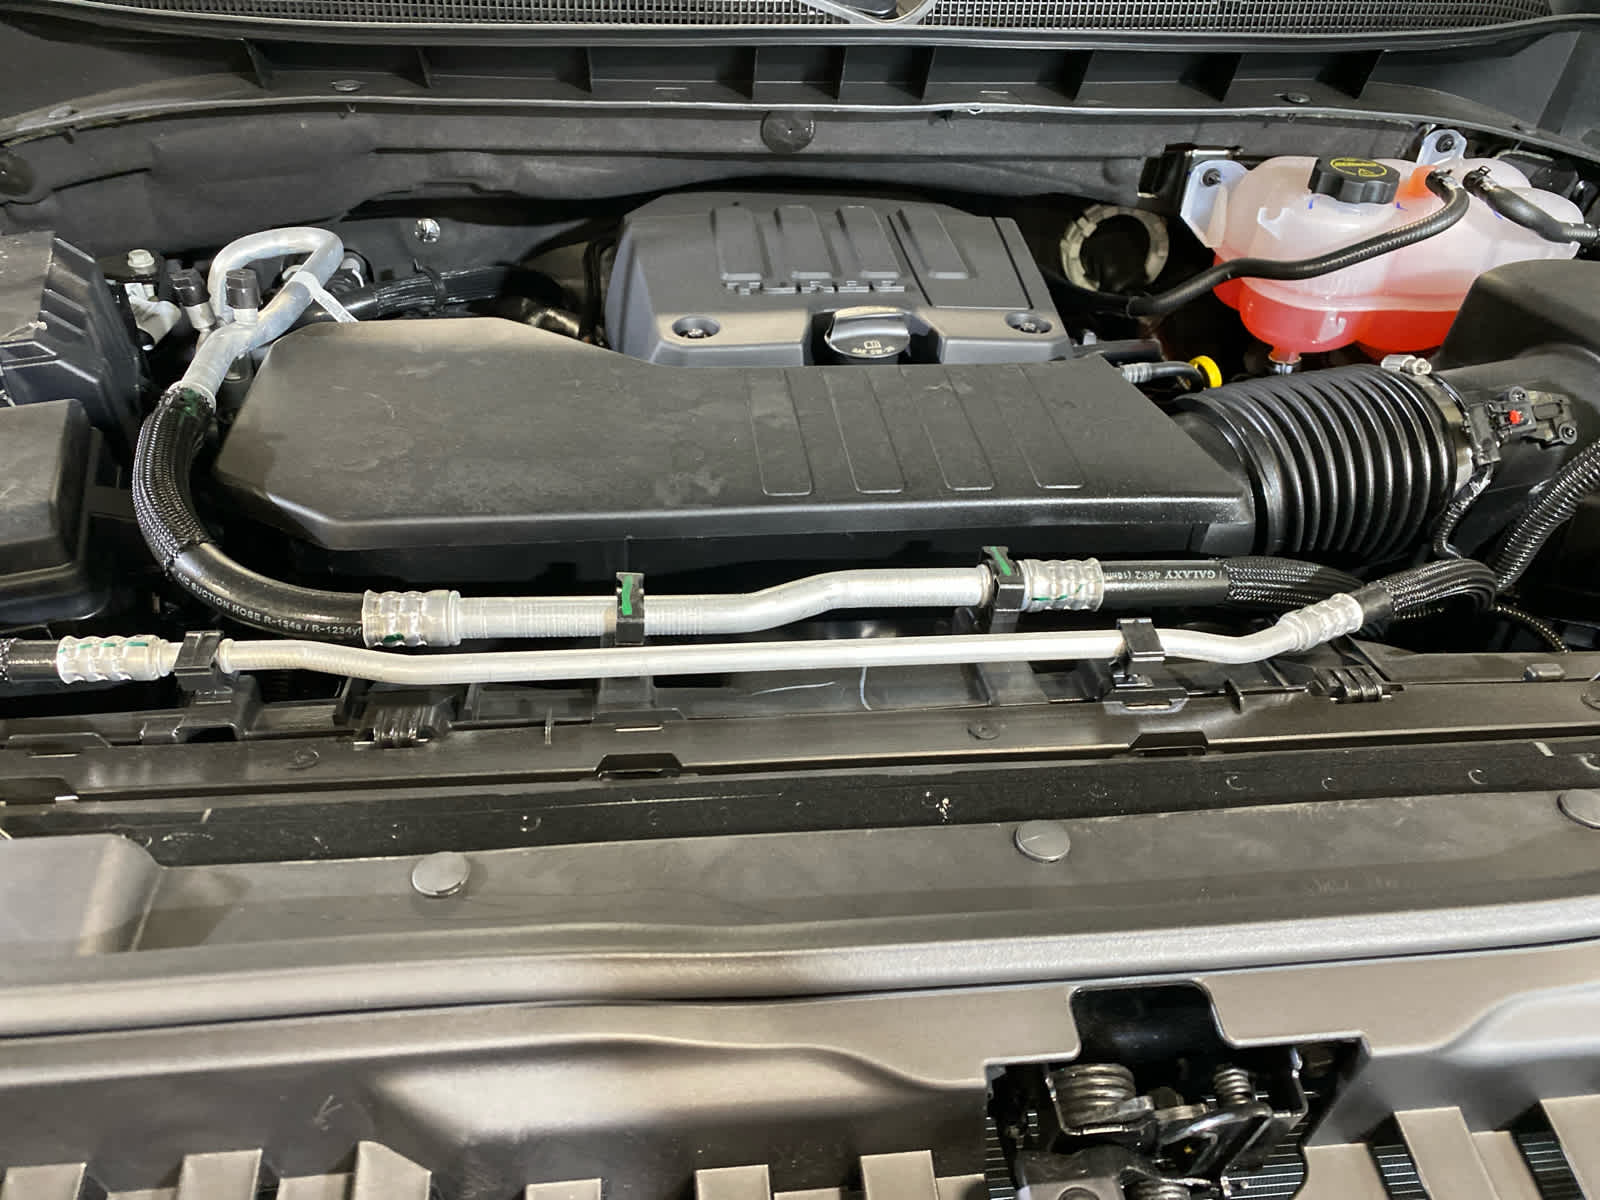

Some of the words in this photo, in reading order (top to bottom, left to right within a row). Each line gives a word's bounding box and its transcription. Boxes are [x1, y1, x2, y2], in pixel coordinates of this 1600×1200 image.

[1164, 570, 1216, 580] GALAXY
[177, 572, 190, 584] A/C
[191, 581, 231, 611] SUCTION
[232, 603, 261, 622] HOSE
[263, 615, 302, 631] R-134a
[304, 623, 310, 632] /
